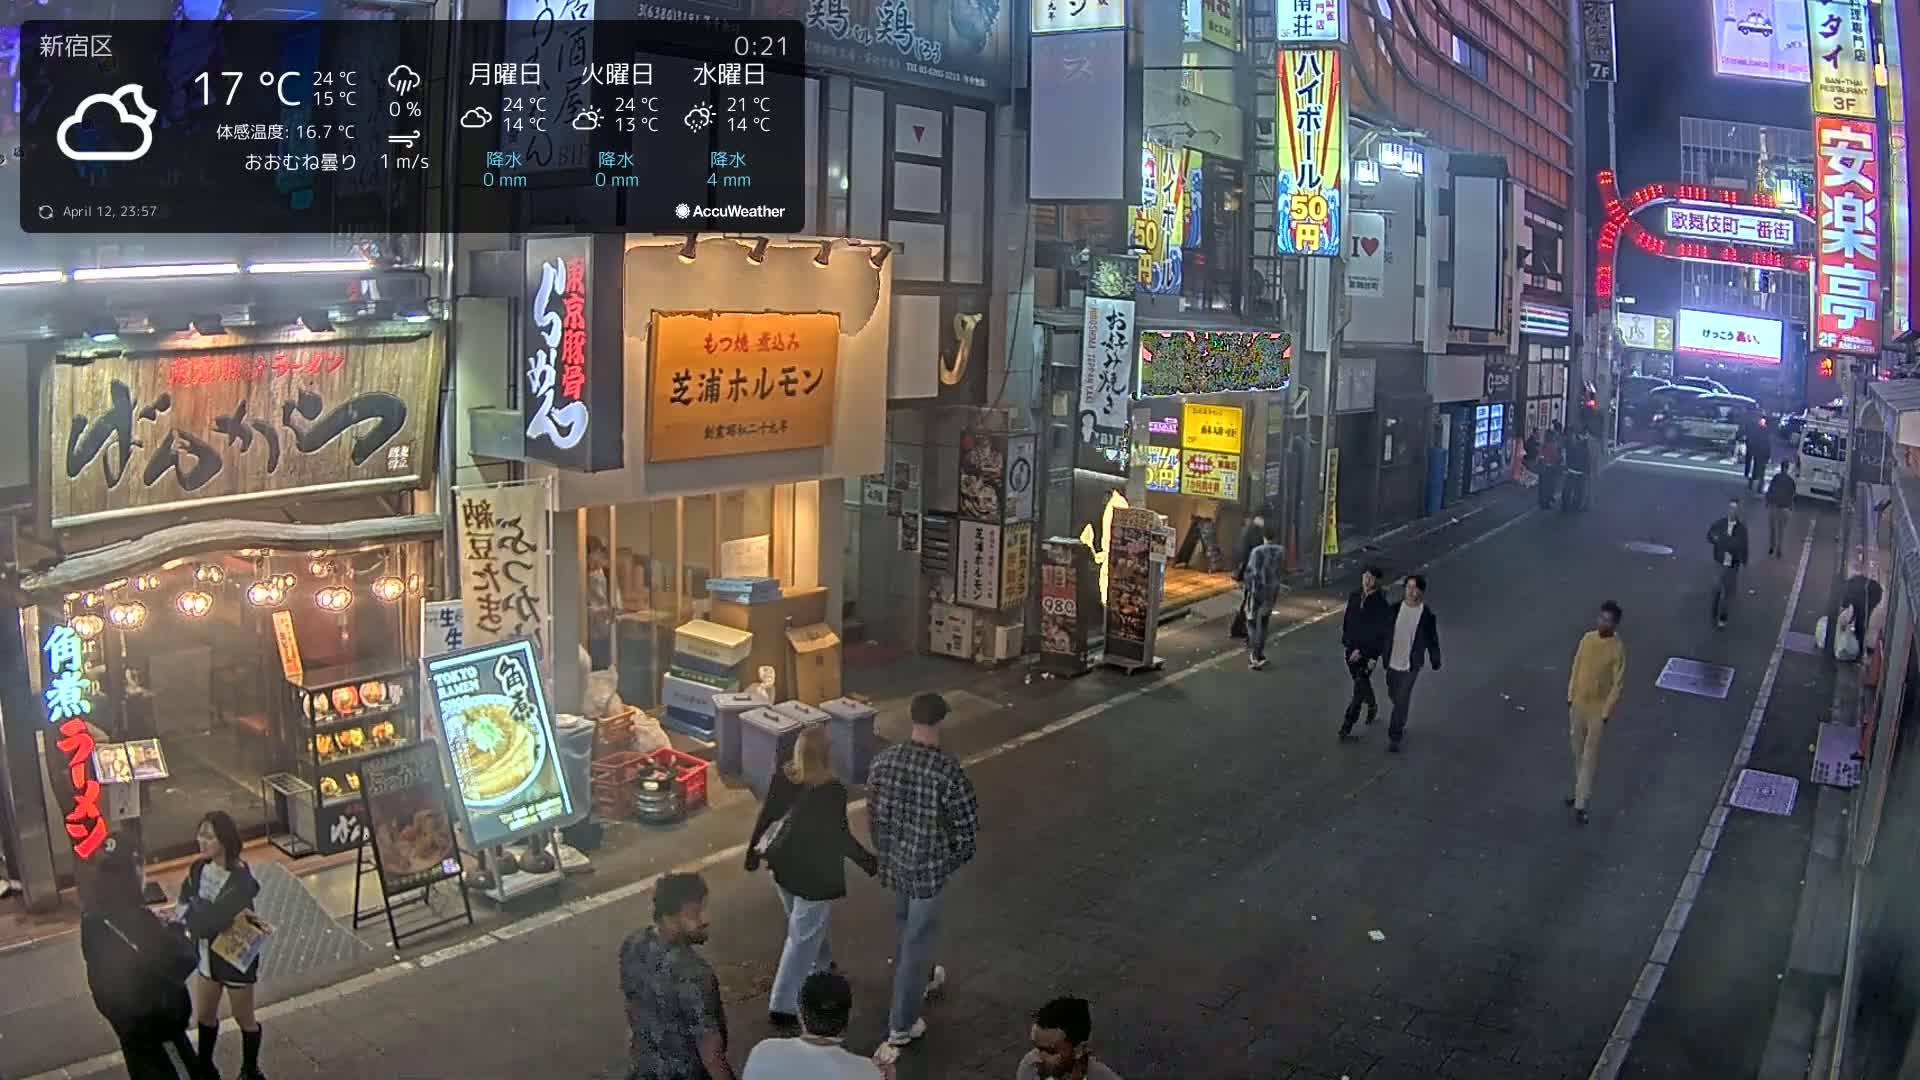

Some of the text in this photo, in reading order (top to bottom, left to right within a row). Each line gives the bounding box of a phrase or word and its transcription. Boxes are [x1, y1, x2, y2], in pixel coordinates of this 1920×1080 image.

[1818, 10, 1843, 69] タイ
[1848, 0, 1865, 62] 理専門店
[1590, 63, 1609, 79] 7F
[1297, 54, 1323, 189] ハイボール
[1833, 97, 1856, 111] 3F
[1671, 210, 1790, 241] 歌舞伎町一番街
[1819, 125, 1877, 330] 安楽亭
[562, 255, 586, 400] 東京豚骨
[704, 332, 748, 354] もつ焼
[670, 366, 824, 406] 芝浦ホルモン
[1098, 308, 1128, 415] お好み焼き
[66, 378, 408, 491] ばんから
